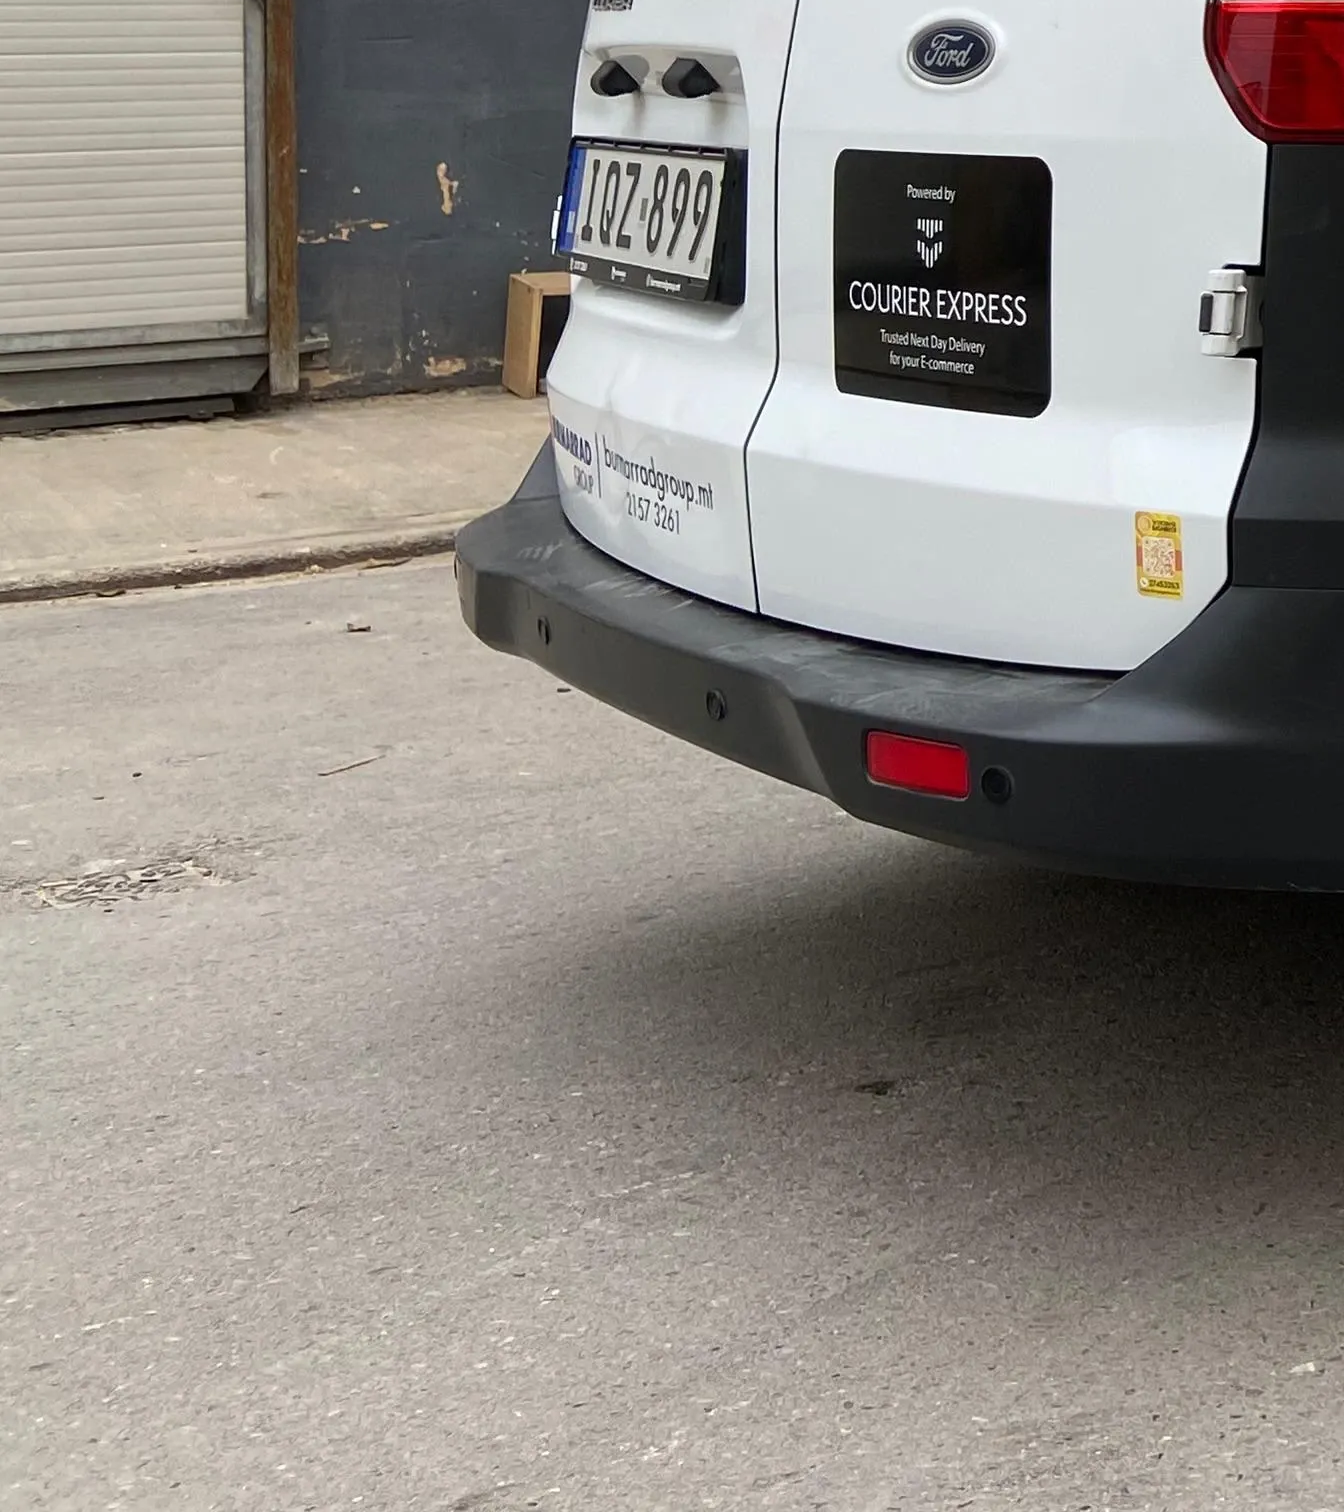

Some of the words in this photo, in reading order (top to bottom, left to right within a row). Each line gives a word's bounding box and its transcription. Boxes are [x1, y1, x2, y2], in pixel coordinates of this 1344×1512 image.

[923, 32, 974, 70] Ford
[907, 184, 943, 200] Powered
[944, 186, 956, 204] by
[849, 280, 932, 318] COURIER
[936, 289, 1027, 327] EXPRESS
[880, 329, 909, 345] Trusted
[910, 333, 929, 349] Next
[931, 335, 948, 353] Day
[949, 337, 986, 357] Delivery
[889, 350, 901, 366] for
[901, 356, 921, 369] your
[921, 355, 975, 375] E-commerce
[626, 491, 650, 522] 2157
[654, 502, 680, 535] 3261
